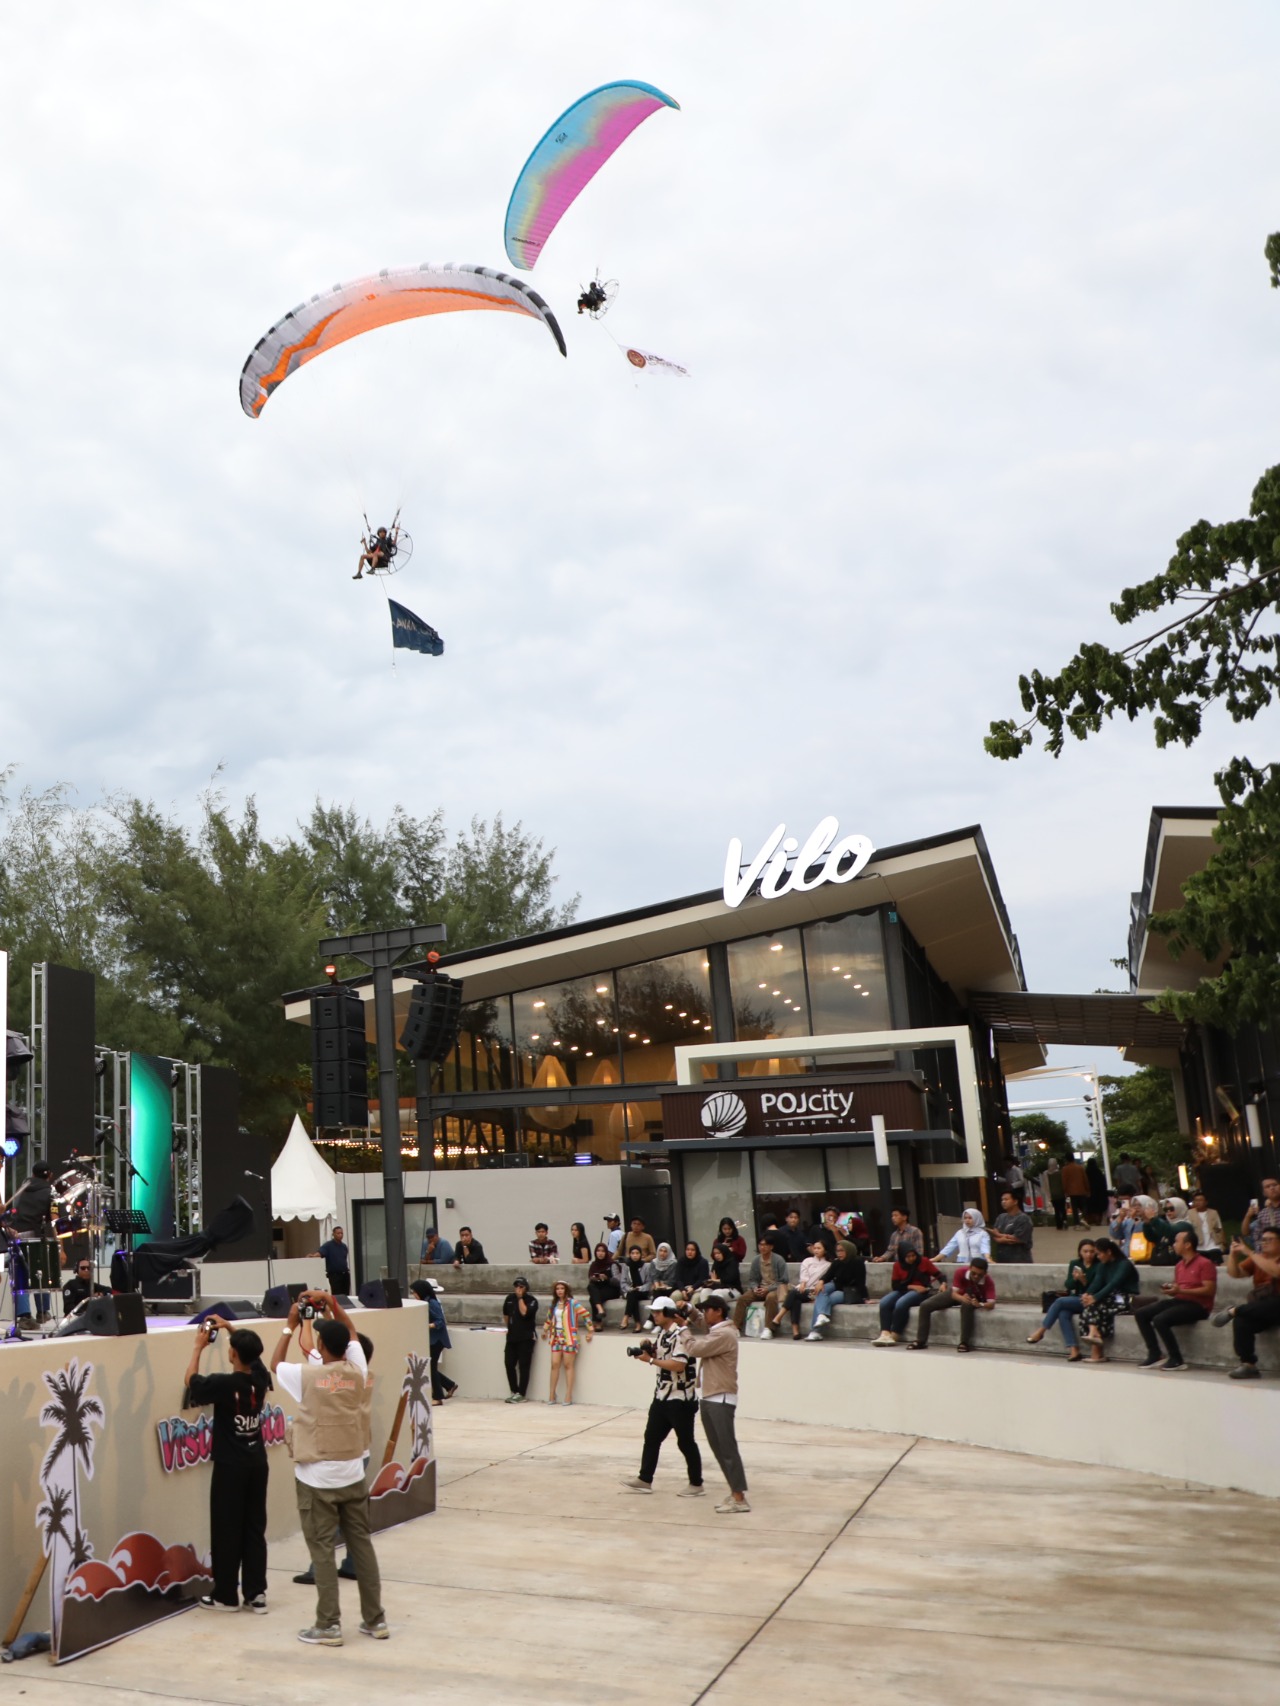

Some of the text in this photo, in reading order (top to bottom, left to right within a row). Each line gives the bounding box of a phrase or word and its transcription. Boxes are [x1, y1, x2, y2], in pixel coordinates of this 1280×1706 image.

[723, 815, 877, 908] Vilo
[760, 1088, 854, 1117] POJcity
[765, 1118, 856, 1128] SEMARANG
